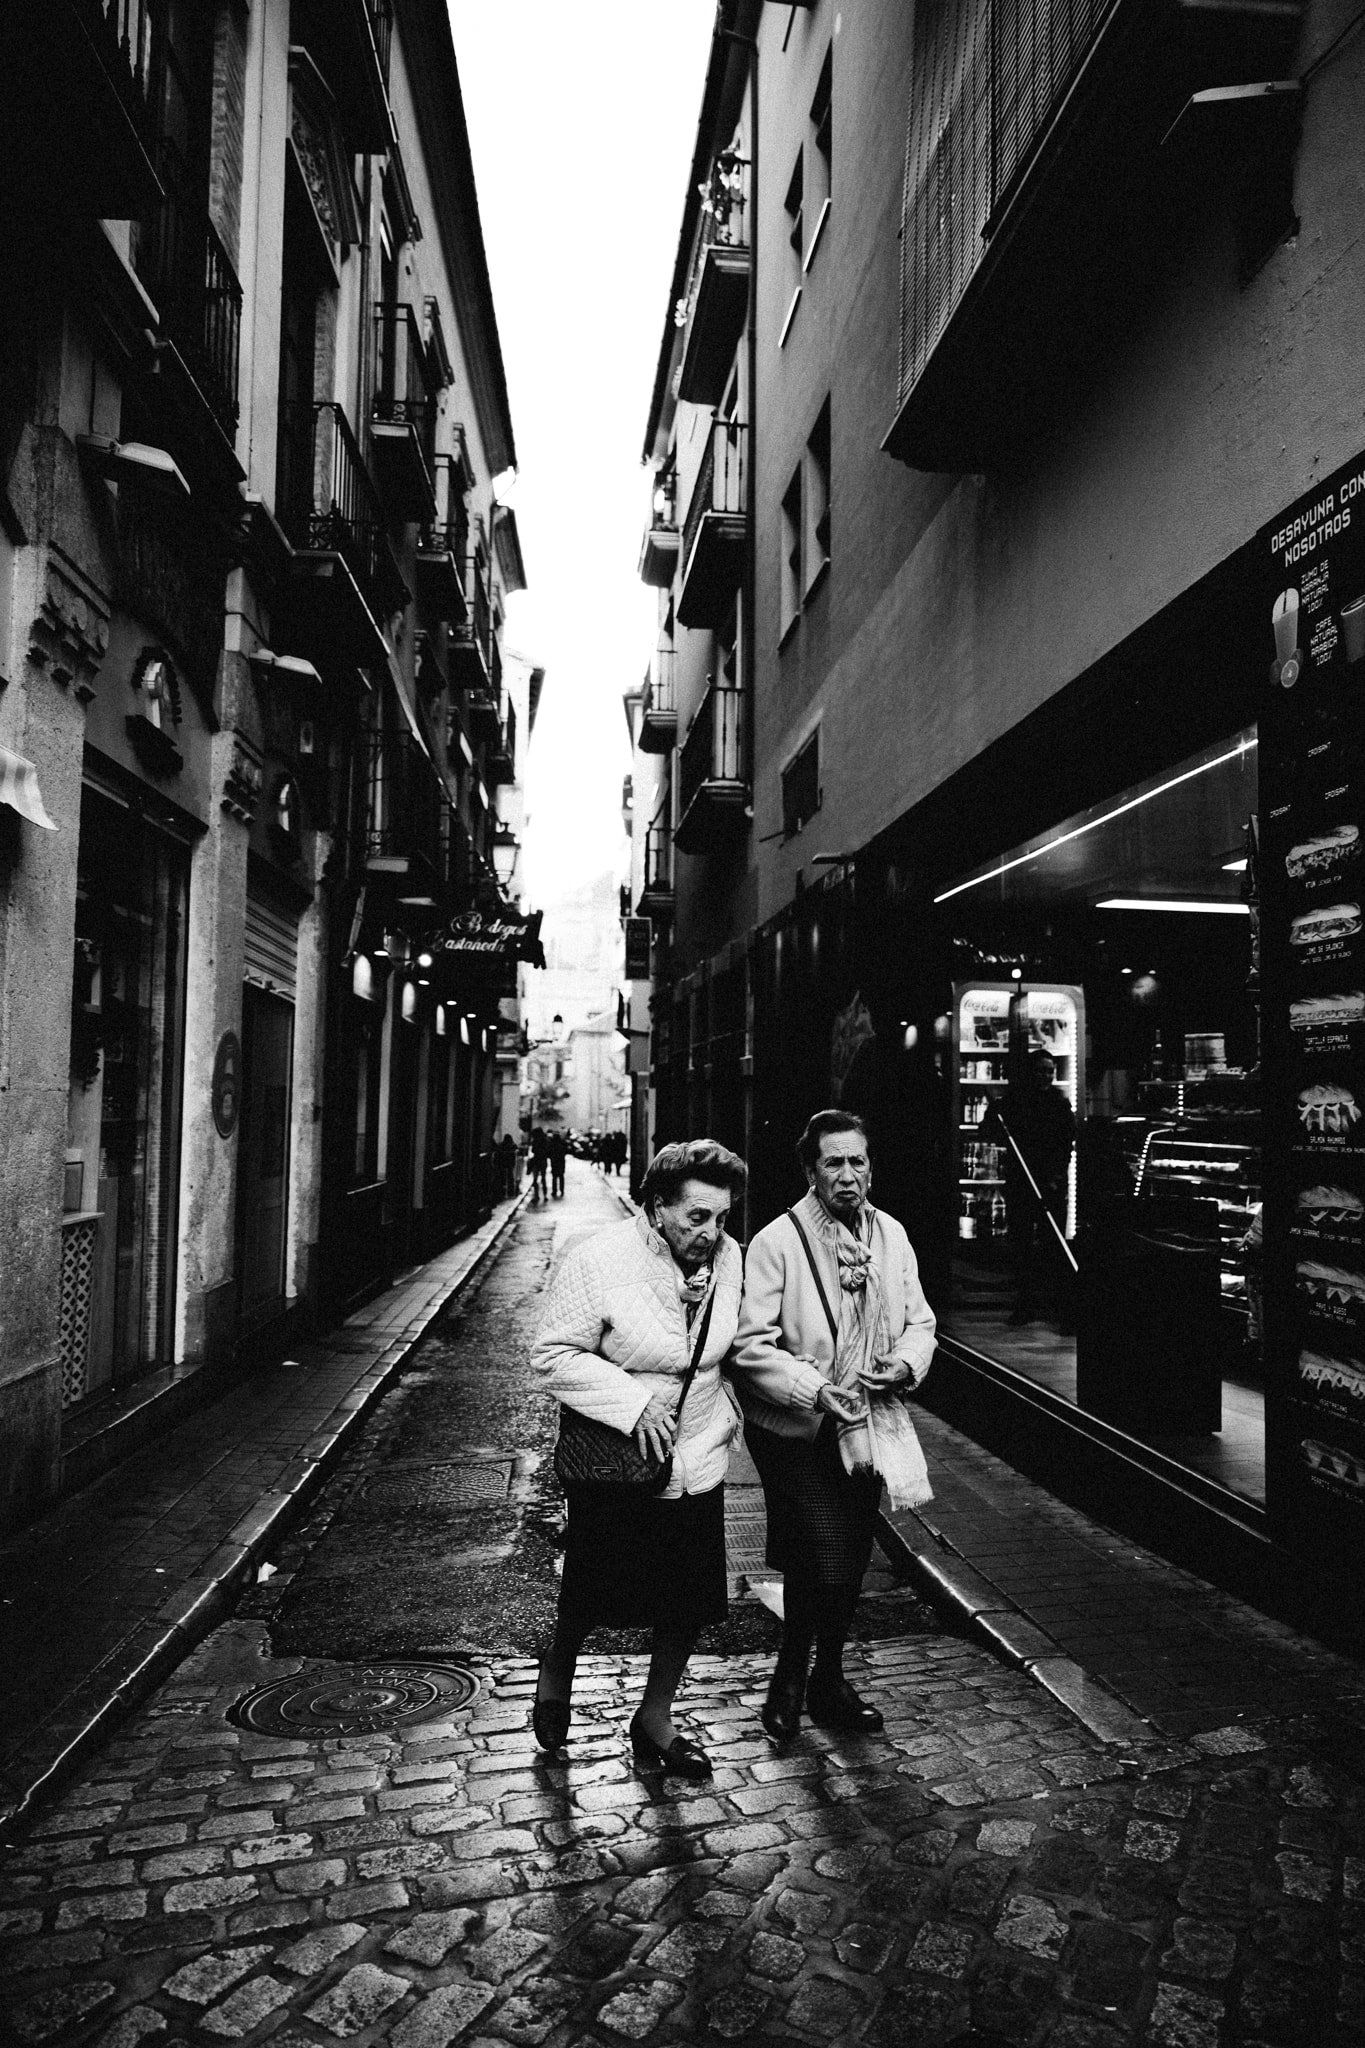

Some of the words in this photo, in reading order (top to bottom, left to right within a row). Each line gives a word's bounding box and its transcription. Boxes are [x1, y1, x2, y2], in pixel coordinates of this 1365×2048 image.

[1271, 494, 1334, 554] DESAYUNA
[1340, 471, 1365, 504] CON
[1284, 507, 1351, 567] NOSOTROS
[1301, 566, 1318, 585] ZUMO
[1320, 559, 1329, 572] DE
[1301, 570, 1330, 594] NARANJA
[1301, 583, 1330, 605] NATURAL
[1307, 597, 1323, 614] 100%
[1310, 625, 1339, 646] NATURAL
[1311, 635, 1338, 657] ARABICA
[1316, 650, 1333, 667] 100%
